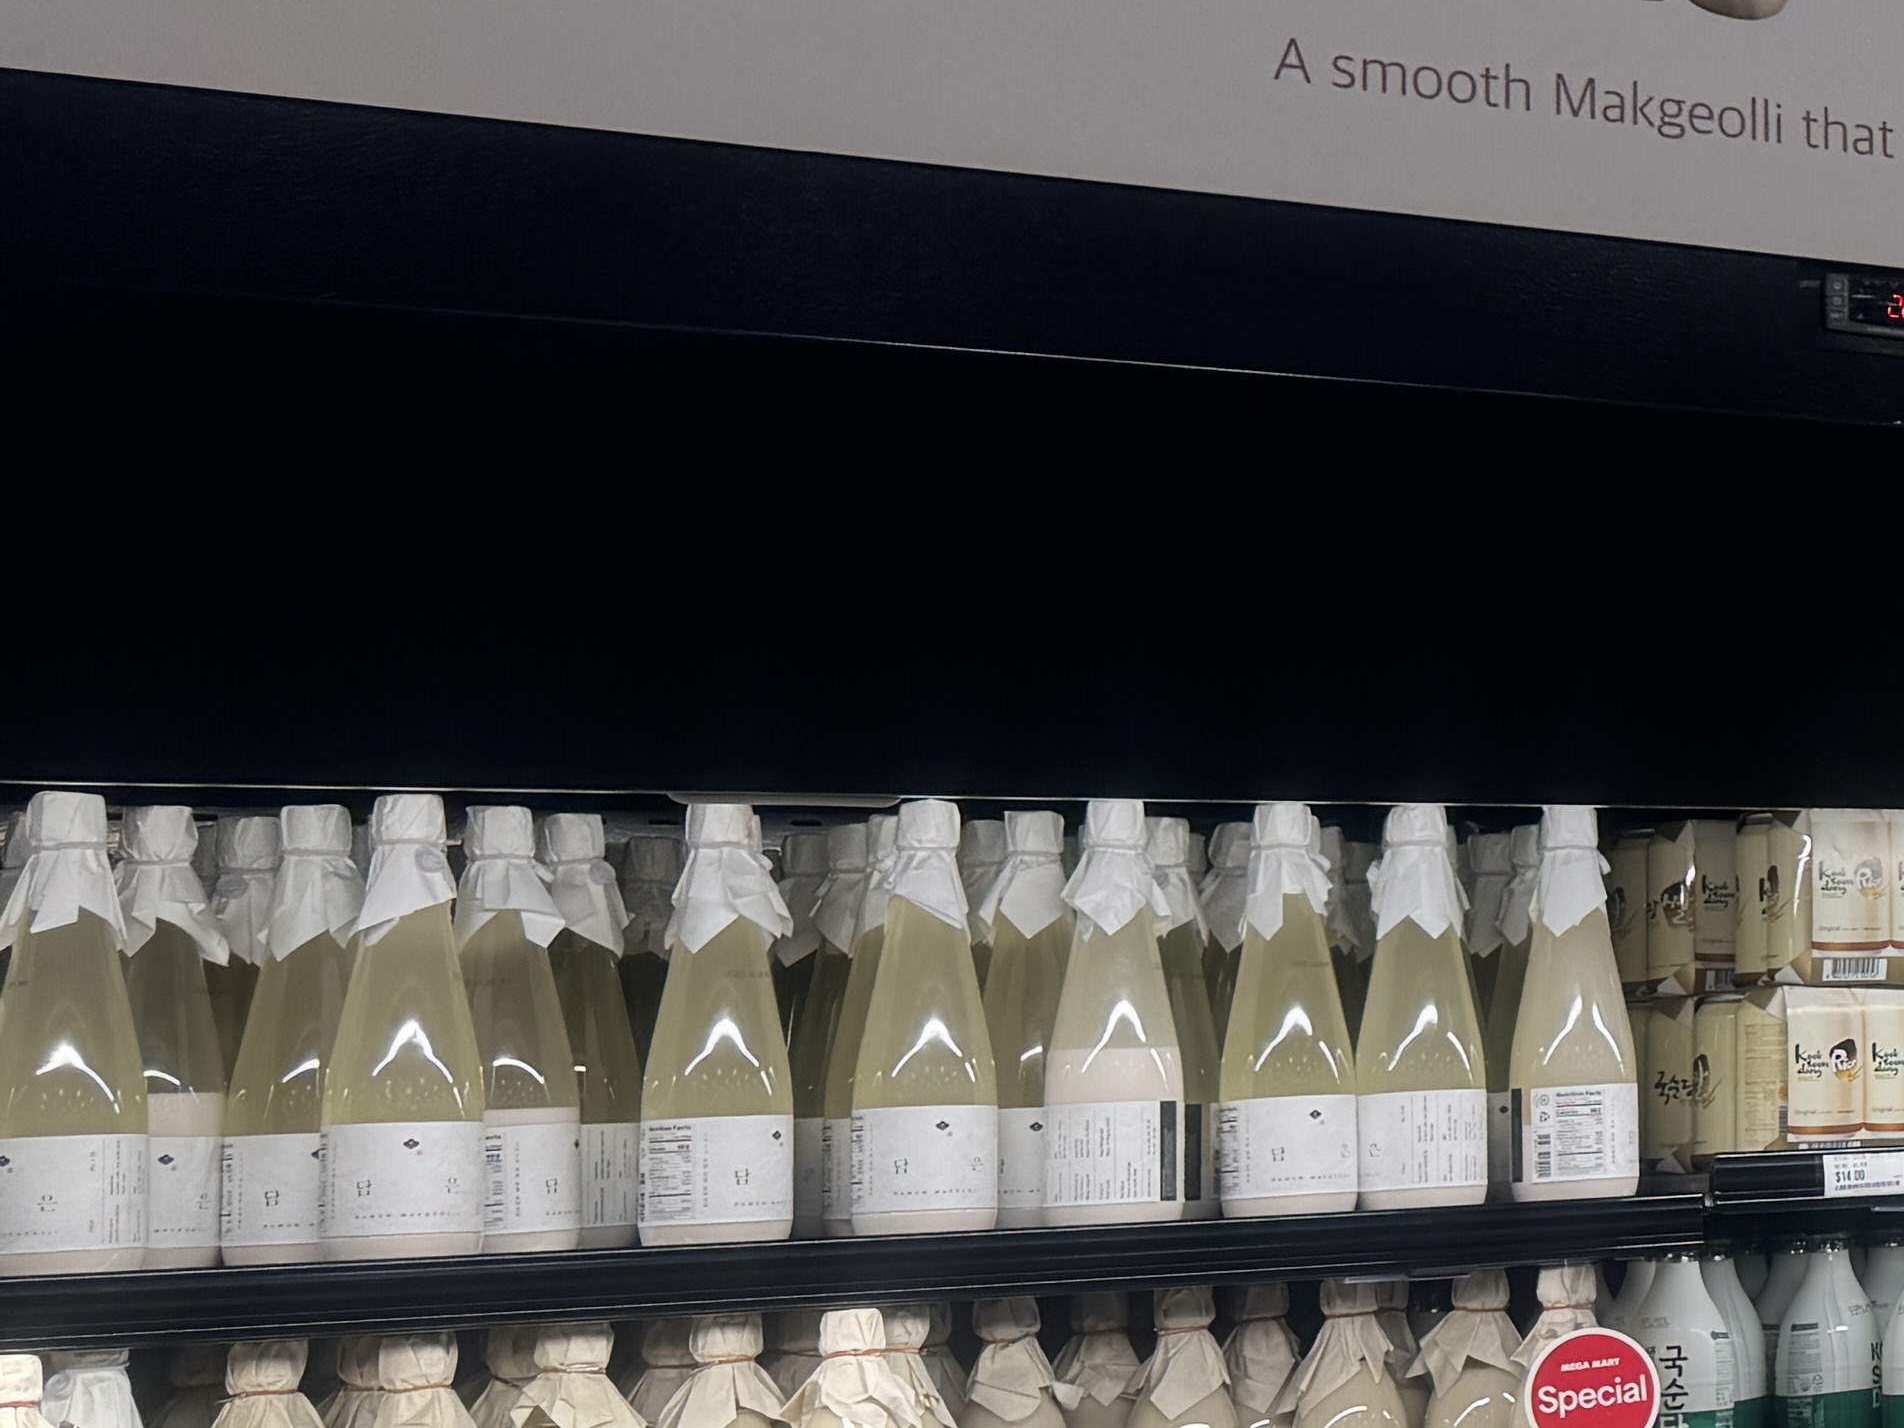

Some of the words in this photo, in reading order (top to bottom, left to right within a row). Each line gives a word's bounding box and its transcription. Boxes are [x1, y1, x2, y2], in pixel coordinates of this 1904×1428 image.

[1274, 37, 1311, 85] A
[1331, 53, 1532, 112] smooth
[1554, 72, 1784, 145] Makgeolli
[1802, 107, 1894, 160] that
[1560, 1360, 1590, 1372] MEGA
[1591, 1357, 1620, 1368] MART
[1538, 1374, 1648, 1419] Special
